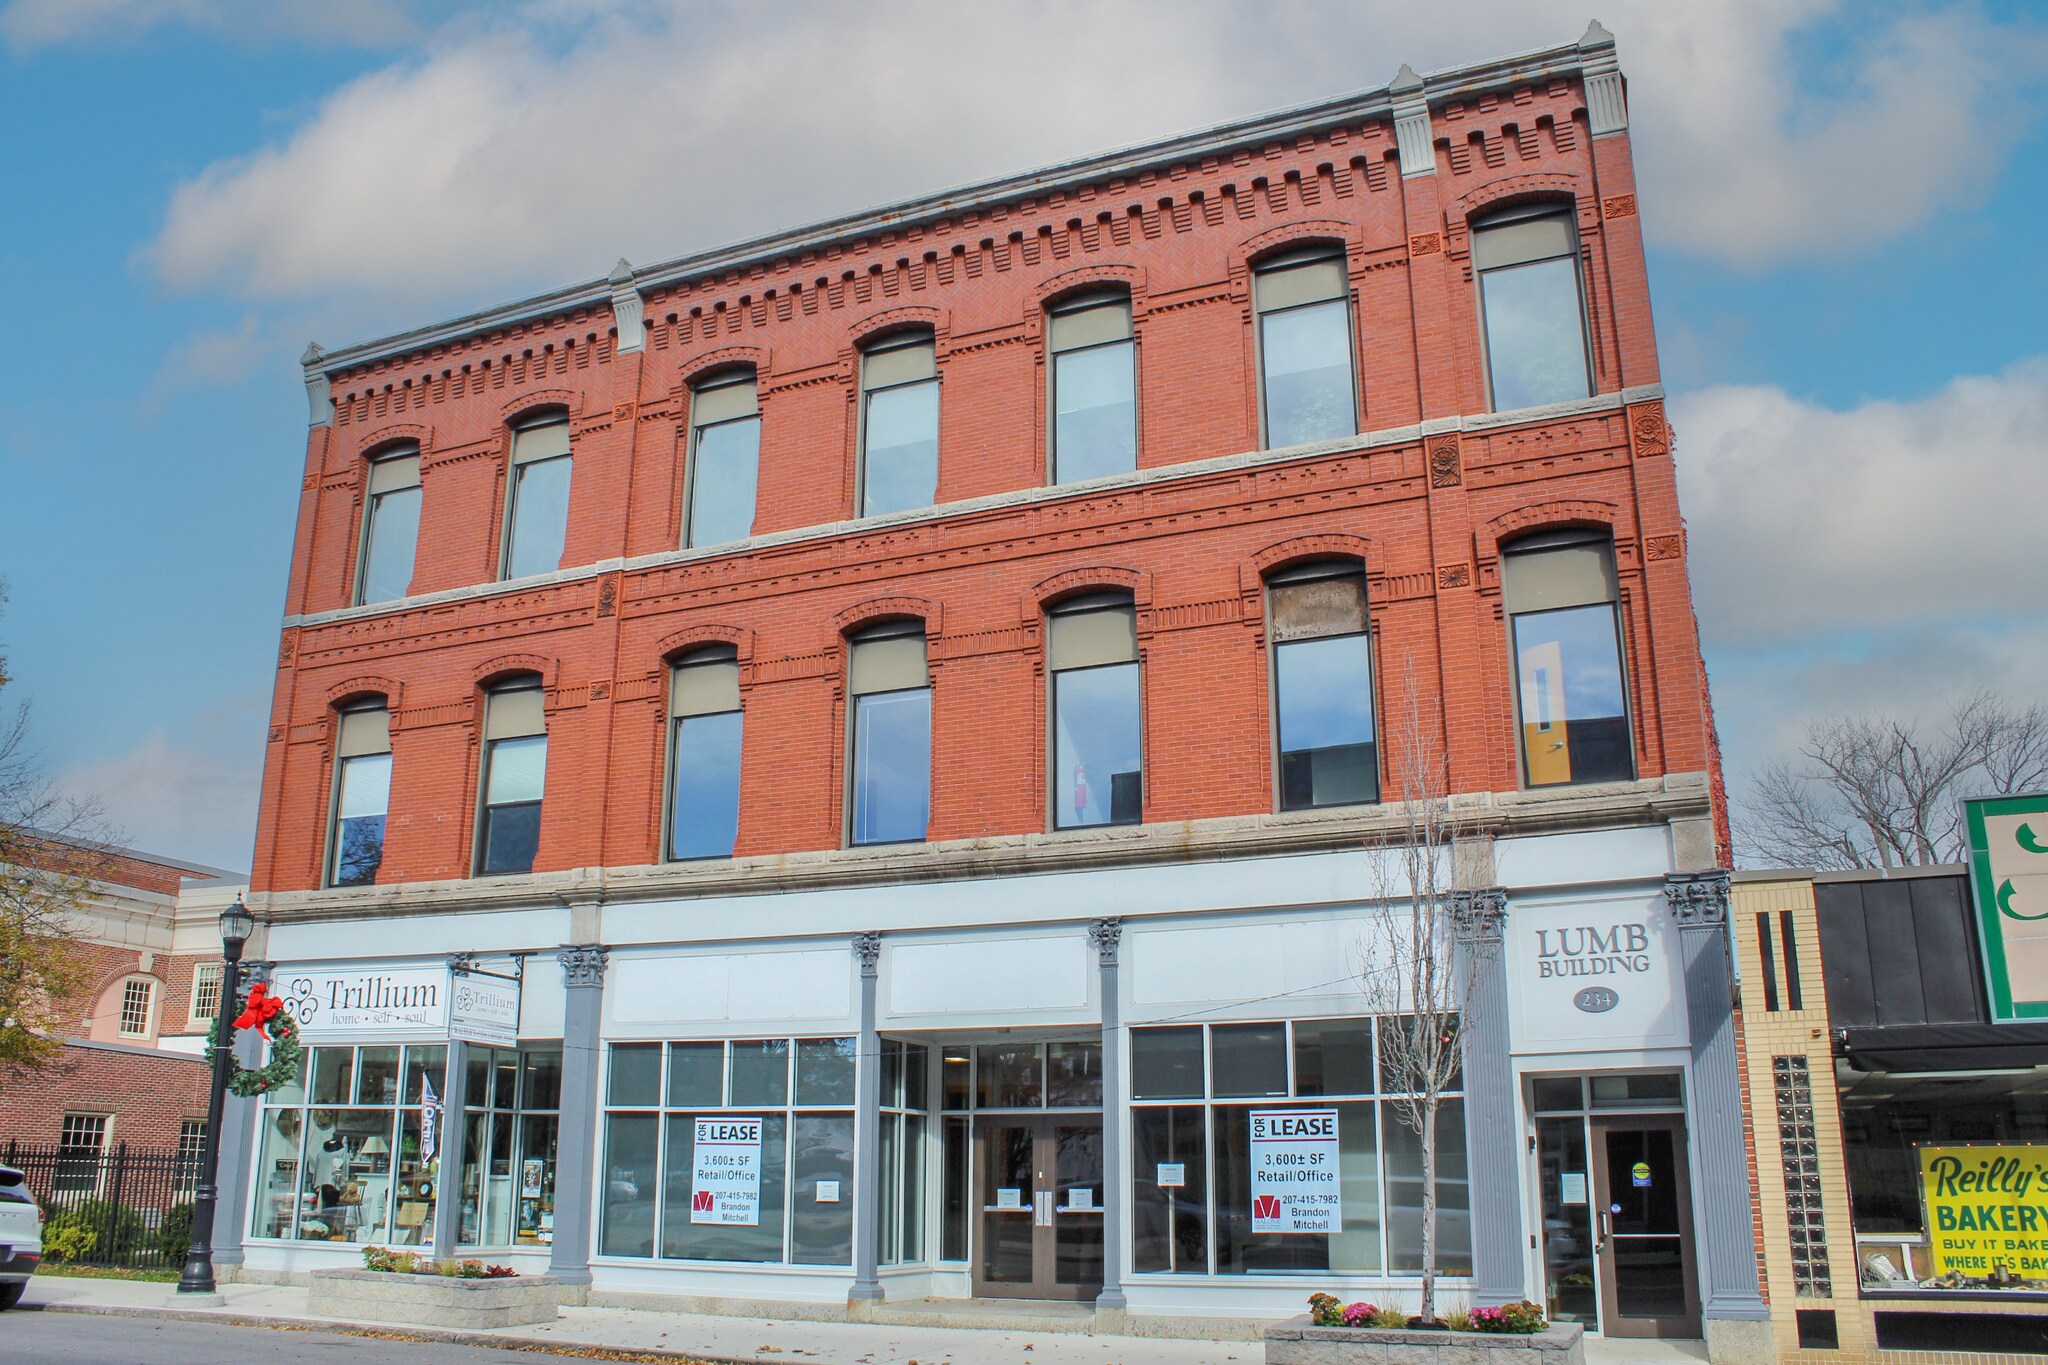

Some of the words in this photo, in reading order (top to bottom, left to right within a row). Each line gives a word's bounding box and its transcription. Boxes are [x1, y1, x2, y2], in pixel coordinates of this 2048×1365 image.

[1535, 923, 1649, 958] LUMB
[1538, 954, 1650, 978] BUILDING
[326, 976, 438, 1010] Trillium
[1582, 992, 1611, 1006] 234
[474, 991, 515, 1010] Trillium
[331, 1012, 361, 1025] home
[372, 1011, 392, 1025] self
[404, 1010, 427, 1024] soul
[697, 1123, 707, 1141] FOR
[710, 1125, 758, 1140] LEASE
[1254, 1118, 1265, 1138] FOR
[1270, 1118, 1334, 1136] LEASE
[704, 1155, 735, 1167] 3,600±
[737, 1155, 751, 1166] SF
[1265, 1153, 1306, 1167] 3,600±
[1309, 1153, 1325, 1165] SF
[697, 1169, 756, 1181] Retail/Office
[1257, 1170, 1334, 1183] Retail/Office
[1929, 1155, 2048, 1199] Reilly's
[715, 1191, 758, 1201] 207-415-7982
[1282, 1195, 1339, 1205] 207-415-7982
[721, 1202, 751, 1211] Brandon
[1291, 1207, 1330, 1217] Brandon
[722, 1213, 749, 1223] Mitchell
[1293, 1219, 1329, 1230] Mitchell
[1936, 1205, 2048, 1232] BAKERY
[1943, 1239, 1977, 1249] BUY
[1983, 1239, 1997, 1250] IT
[1943, 1256, 1988, 1269] WHERE
[1992, 1253, 2017, 1270] IT'S
